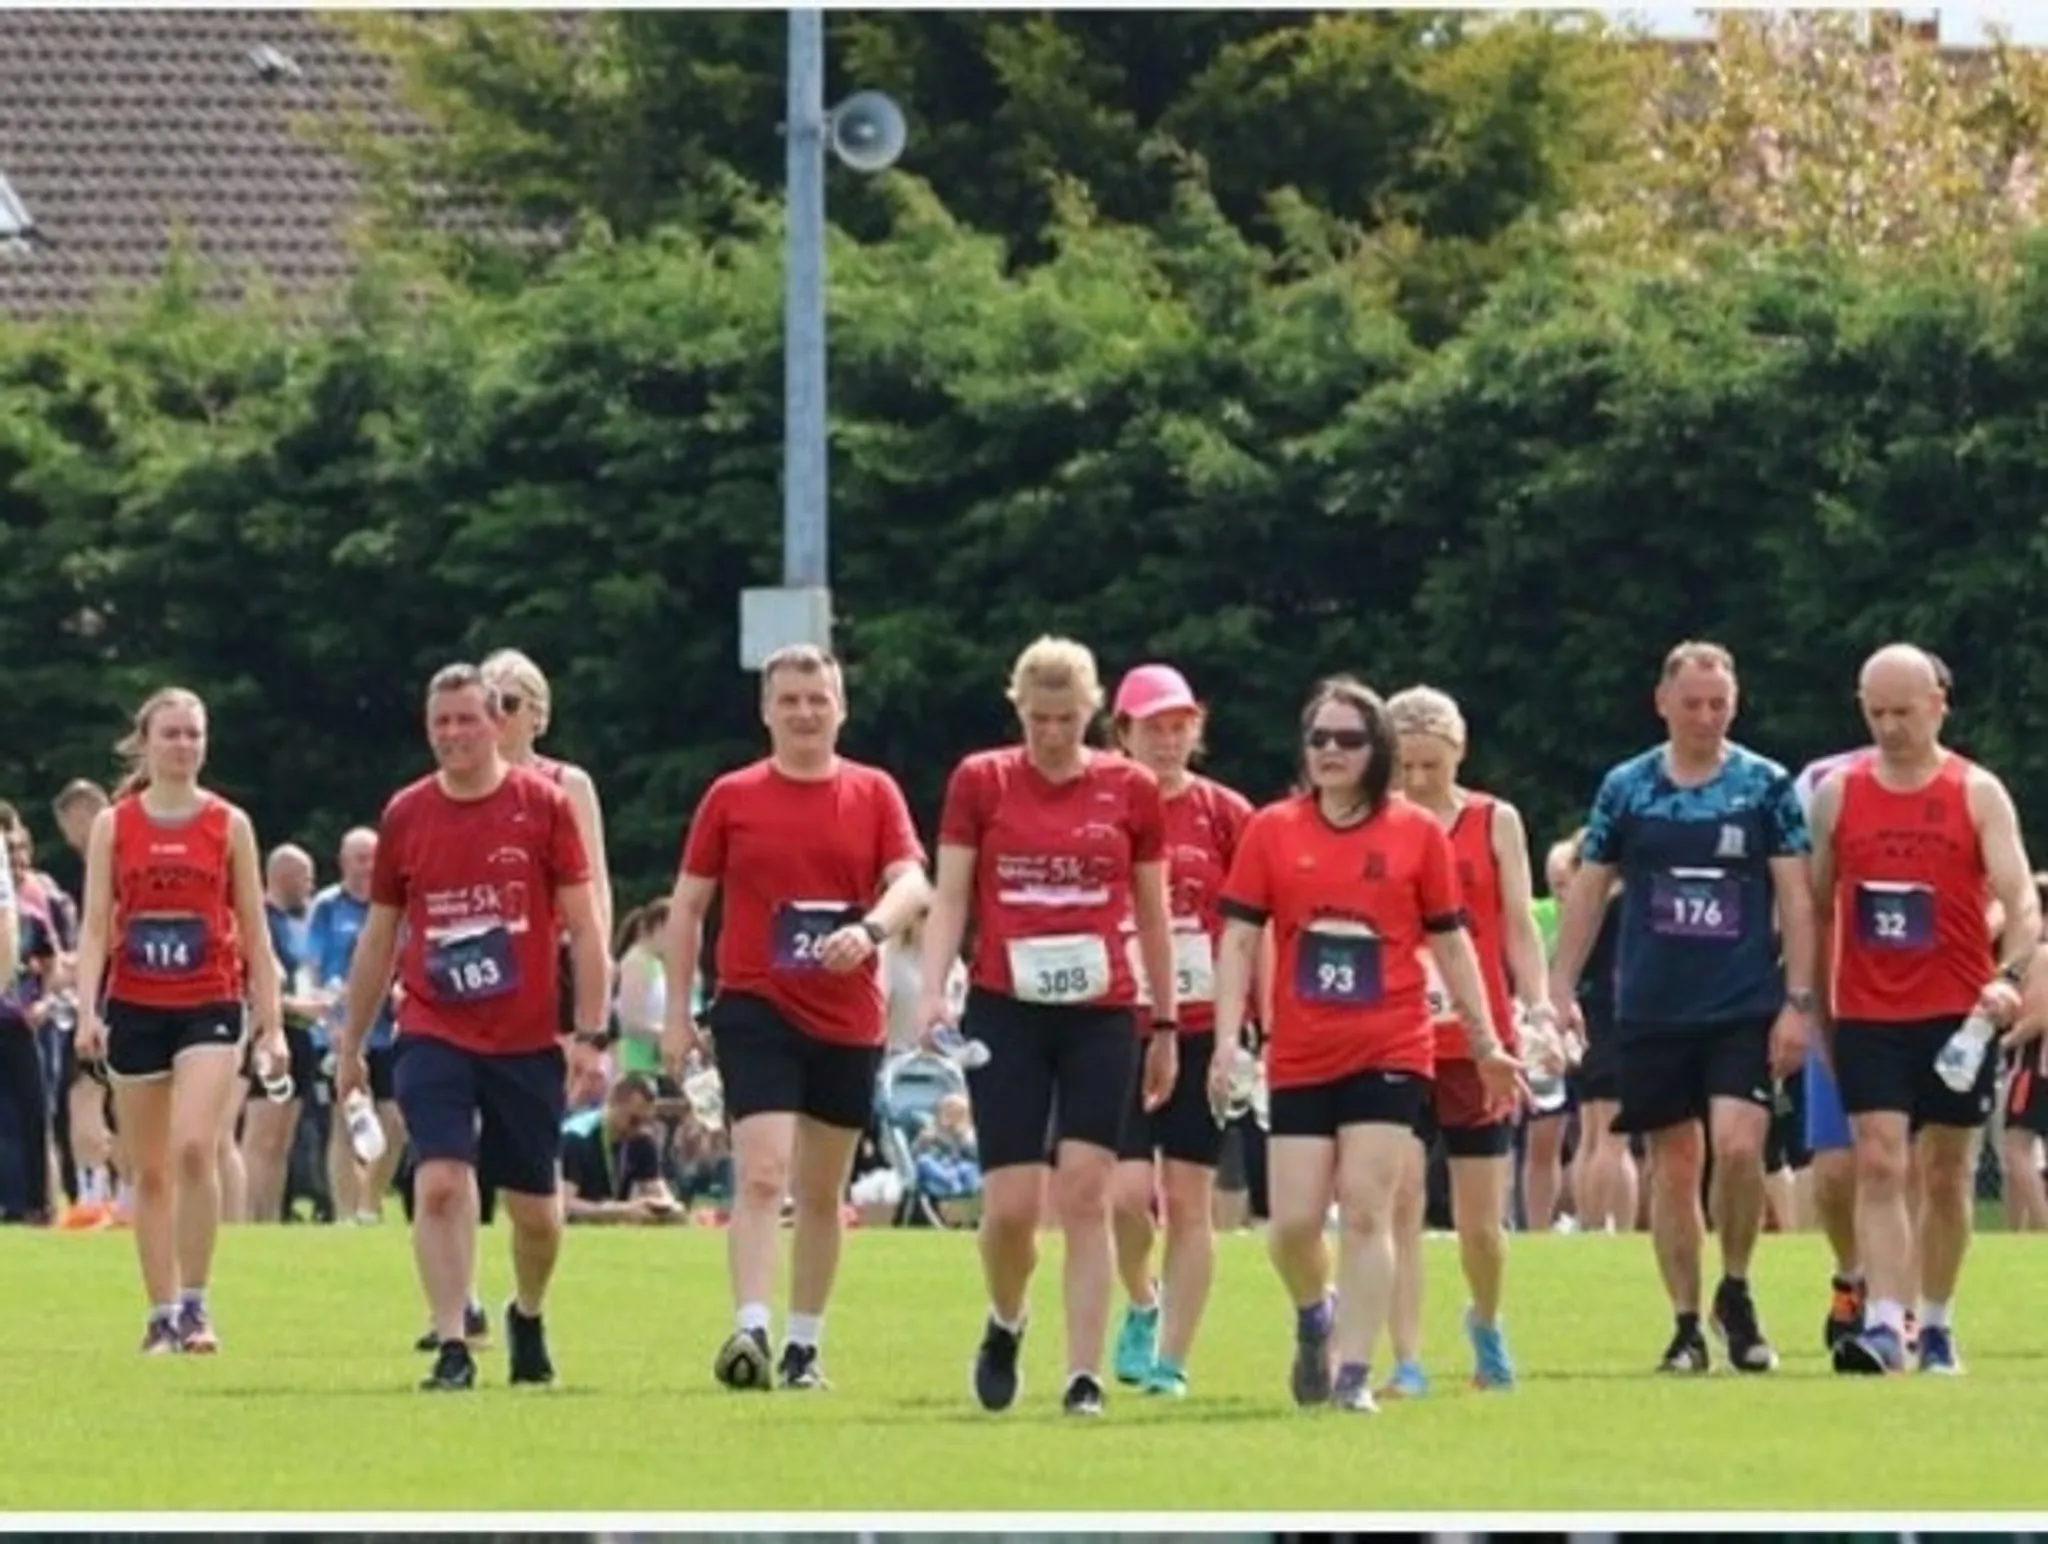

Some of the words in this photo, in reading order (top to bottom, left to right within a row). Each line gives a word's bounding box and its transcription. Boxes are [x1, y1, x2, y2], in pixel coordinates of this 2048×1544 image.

[1673, 898, 1722, 926] 176
[1874, 911, 1907, 939] 32
[144, 941, 190, 967] 114
[449, 957, 501, 993] 183
[1036, 966, 1089, 996] 308
[1317, 963, 1355, 993] 93
